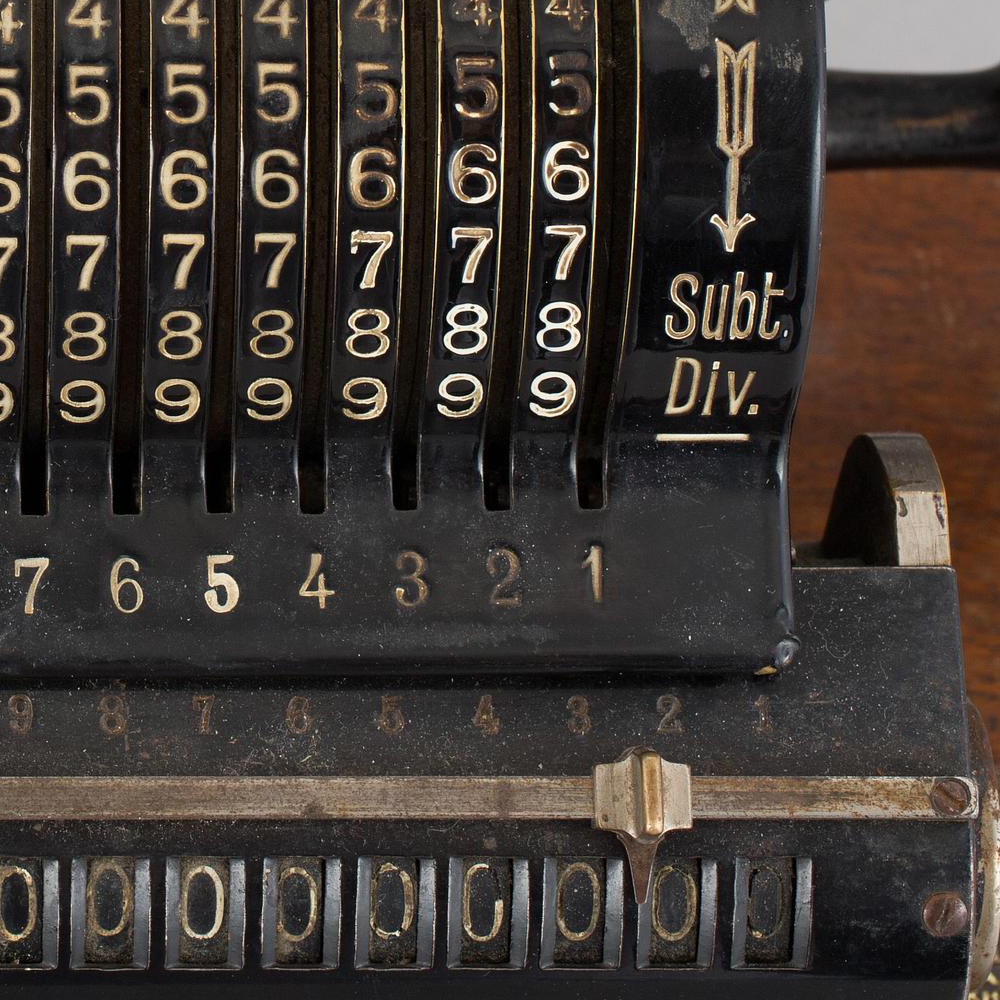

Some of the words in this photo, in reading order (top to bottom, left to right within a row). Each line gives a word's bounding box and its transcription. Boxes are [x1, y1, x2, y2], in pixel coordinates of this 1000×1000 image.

[66, 65, 110, 126] 5
[165, 63, 207, 124] 5
[256, 63, 299, 123] 5
[355, 63, 396, 122] 5
[454, 56, 498, 119] 5
[548, 54, 591, 116] 5
[63, 151, 110, 211] 6
[160, 150, 207, 211] 6
[253, 149, 298, 209] 6
[350, 147, 396, 208] 6
[451, 143, 497, 203] 6
[545, 140, 589, 201] 6
[66, 235, 108, 291] 7
[163, 234, 204, 290] 7
[254, 233, 296, 288] 7
[350, 230, 393, 289] 7
[451, 227, 493, 283] 7
[545, 225, 586, 280] 7
[62, 311, 106, 361] 8
[158, 311, 202, 360] 8
[250, 309, 294, 358] 8
[345, 308, 390, 358] 8
[443, 304, 488, 355] 8
[536, 302, 581, 352] 8
[664, 272, 788, 340] Subt.
[60, 380, 105, 423] 9
[154, 379, 200, 422] 9
[246, 377, 293, 420] 9
[342, 377, 388, 420] 9
[437, 373, 482, 417] 9
[529, 371, 576, 417] 9
[664, 356, 759, 415] Div.
[14, 557, 50, 614] 7
[110, 557, 144, 614] 6
[204, 555, 240, 614] 5
[299, 553, 335, 608] 4
[395, 551, 428, 607] 3
[487, 548, 522, 606] 2
[582, 545, 601, 602] 1
[8, 694, 34, 735] 9
[193, 695, 216, 735] 7
[657, 695, 684, 734] 2
[88, 864, 131, 937] 0
[182, 866, 224, 939] 0
[278, 867, 317, 942] 0
[371, 863, 414, 939] 0
[556, 863, 600, 941] 0
[652, 865, 697, 942] 0
